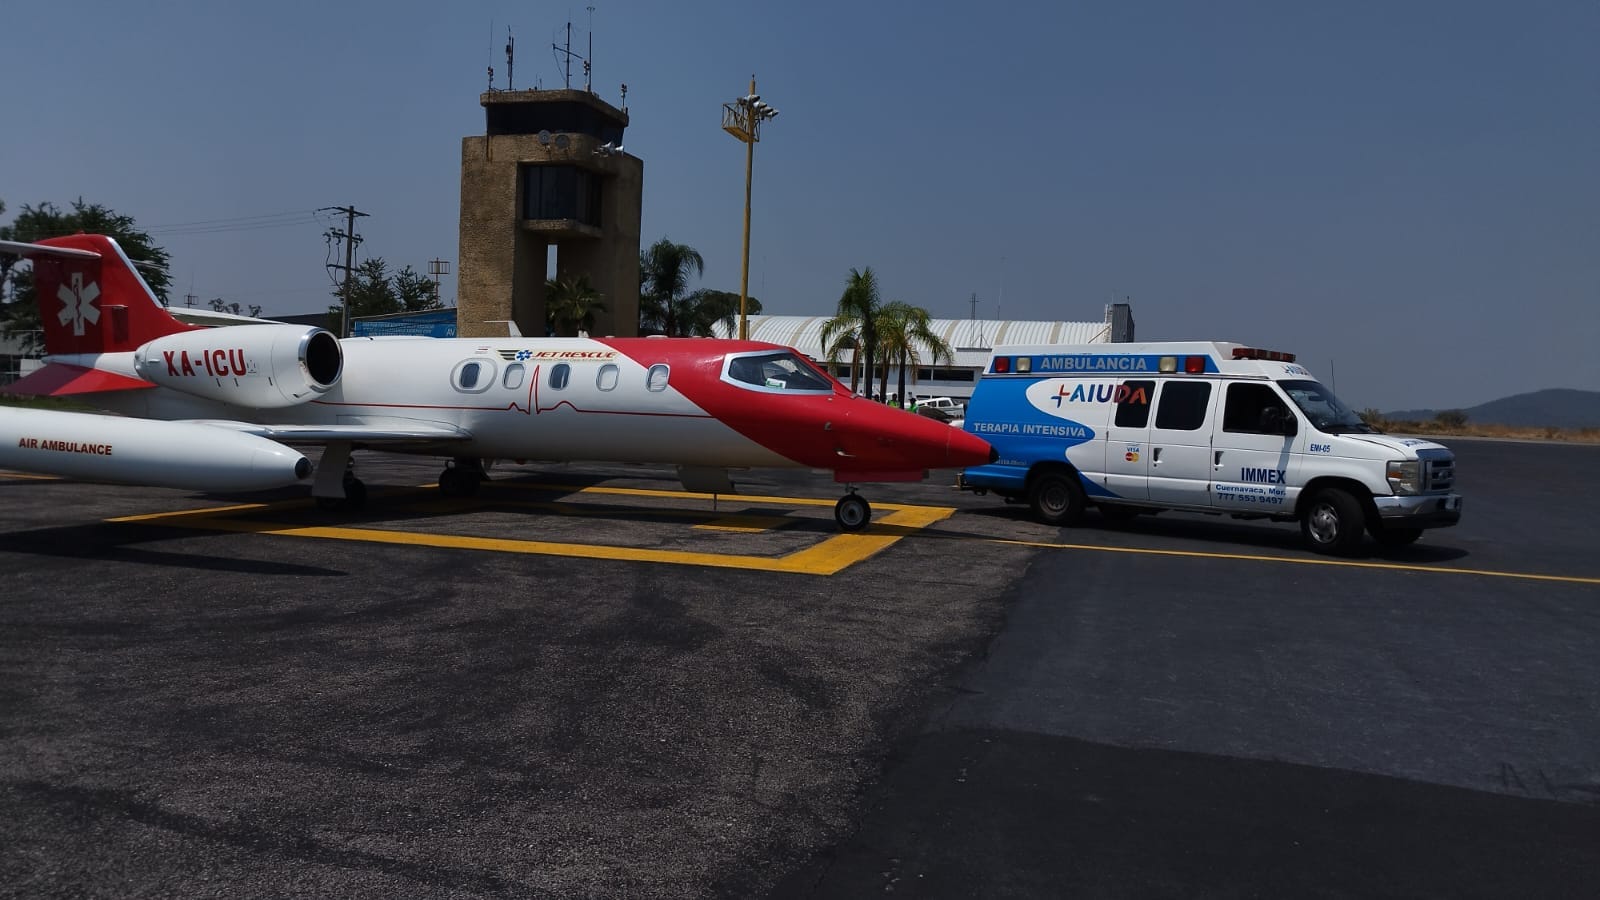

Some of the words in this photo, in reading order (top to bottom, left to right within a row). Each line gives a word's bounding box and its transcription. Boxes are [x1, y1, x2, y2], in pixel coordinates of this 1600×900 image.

[163, 349, 247, 377] XA-ICU
[1040, 357, 1147, 370] AMBULANCIA
[1069, 383, 1147, 405] AIUDA
[974, 422, 1019, 433] TERAPIA
[1022, 424, 1086, 438] INTENSIVA
[19, 438, 38, 449] AIR
[41, 439, 113, 456] AMBULANCE
[1241, 467, 1286, 485] IMMEX
[1216, 484, 1266, 495] Cuernavaca,
[1268, 488, 1286, 496] Mor.
[1217, 492, 1235, 500] 777
[1239, 494, 1257, 503] 553
[1259, 496, 1284, 505] 9497
